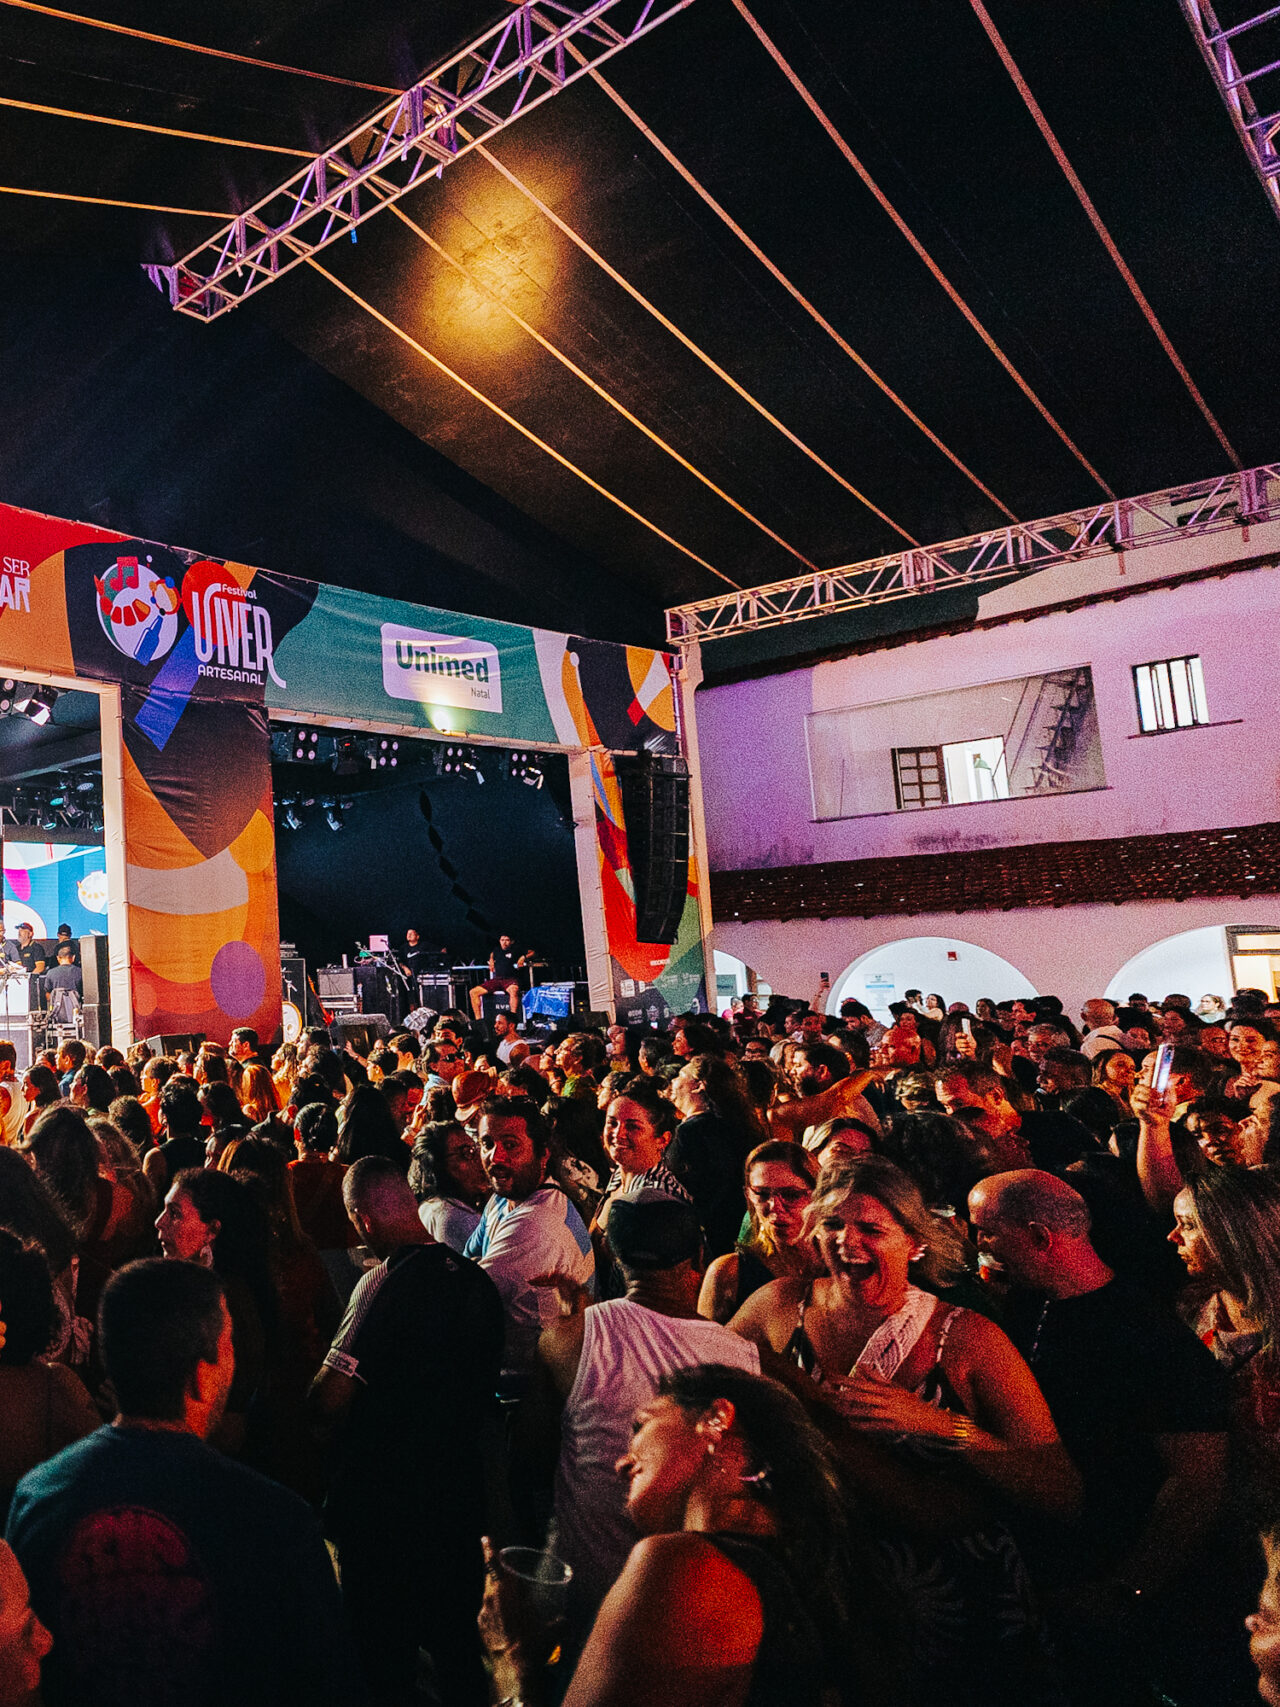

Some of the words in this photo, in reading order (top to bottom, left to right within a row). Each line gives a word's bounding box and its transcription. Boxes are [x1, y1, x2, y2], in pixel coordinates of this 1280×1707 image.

[2, 556, 31, 577] SER
[222, 583, 257, 599] Festival
[395, 640, 489, 683] Unimed
[197, 664, 265, 685] ARTESANAL
[470, 687, 490, 699] Natal
